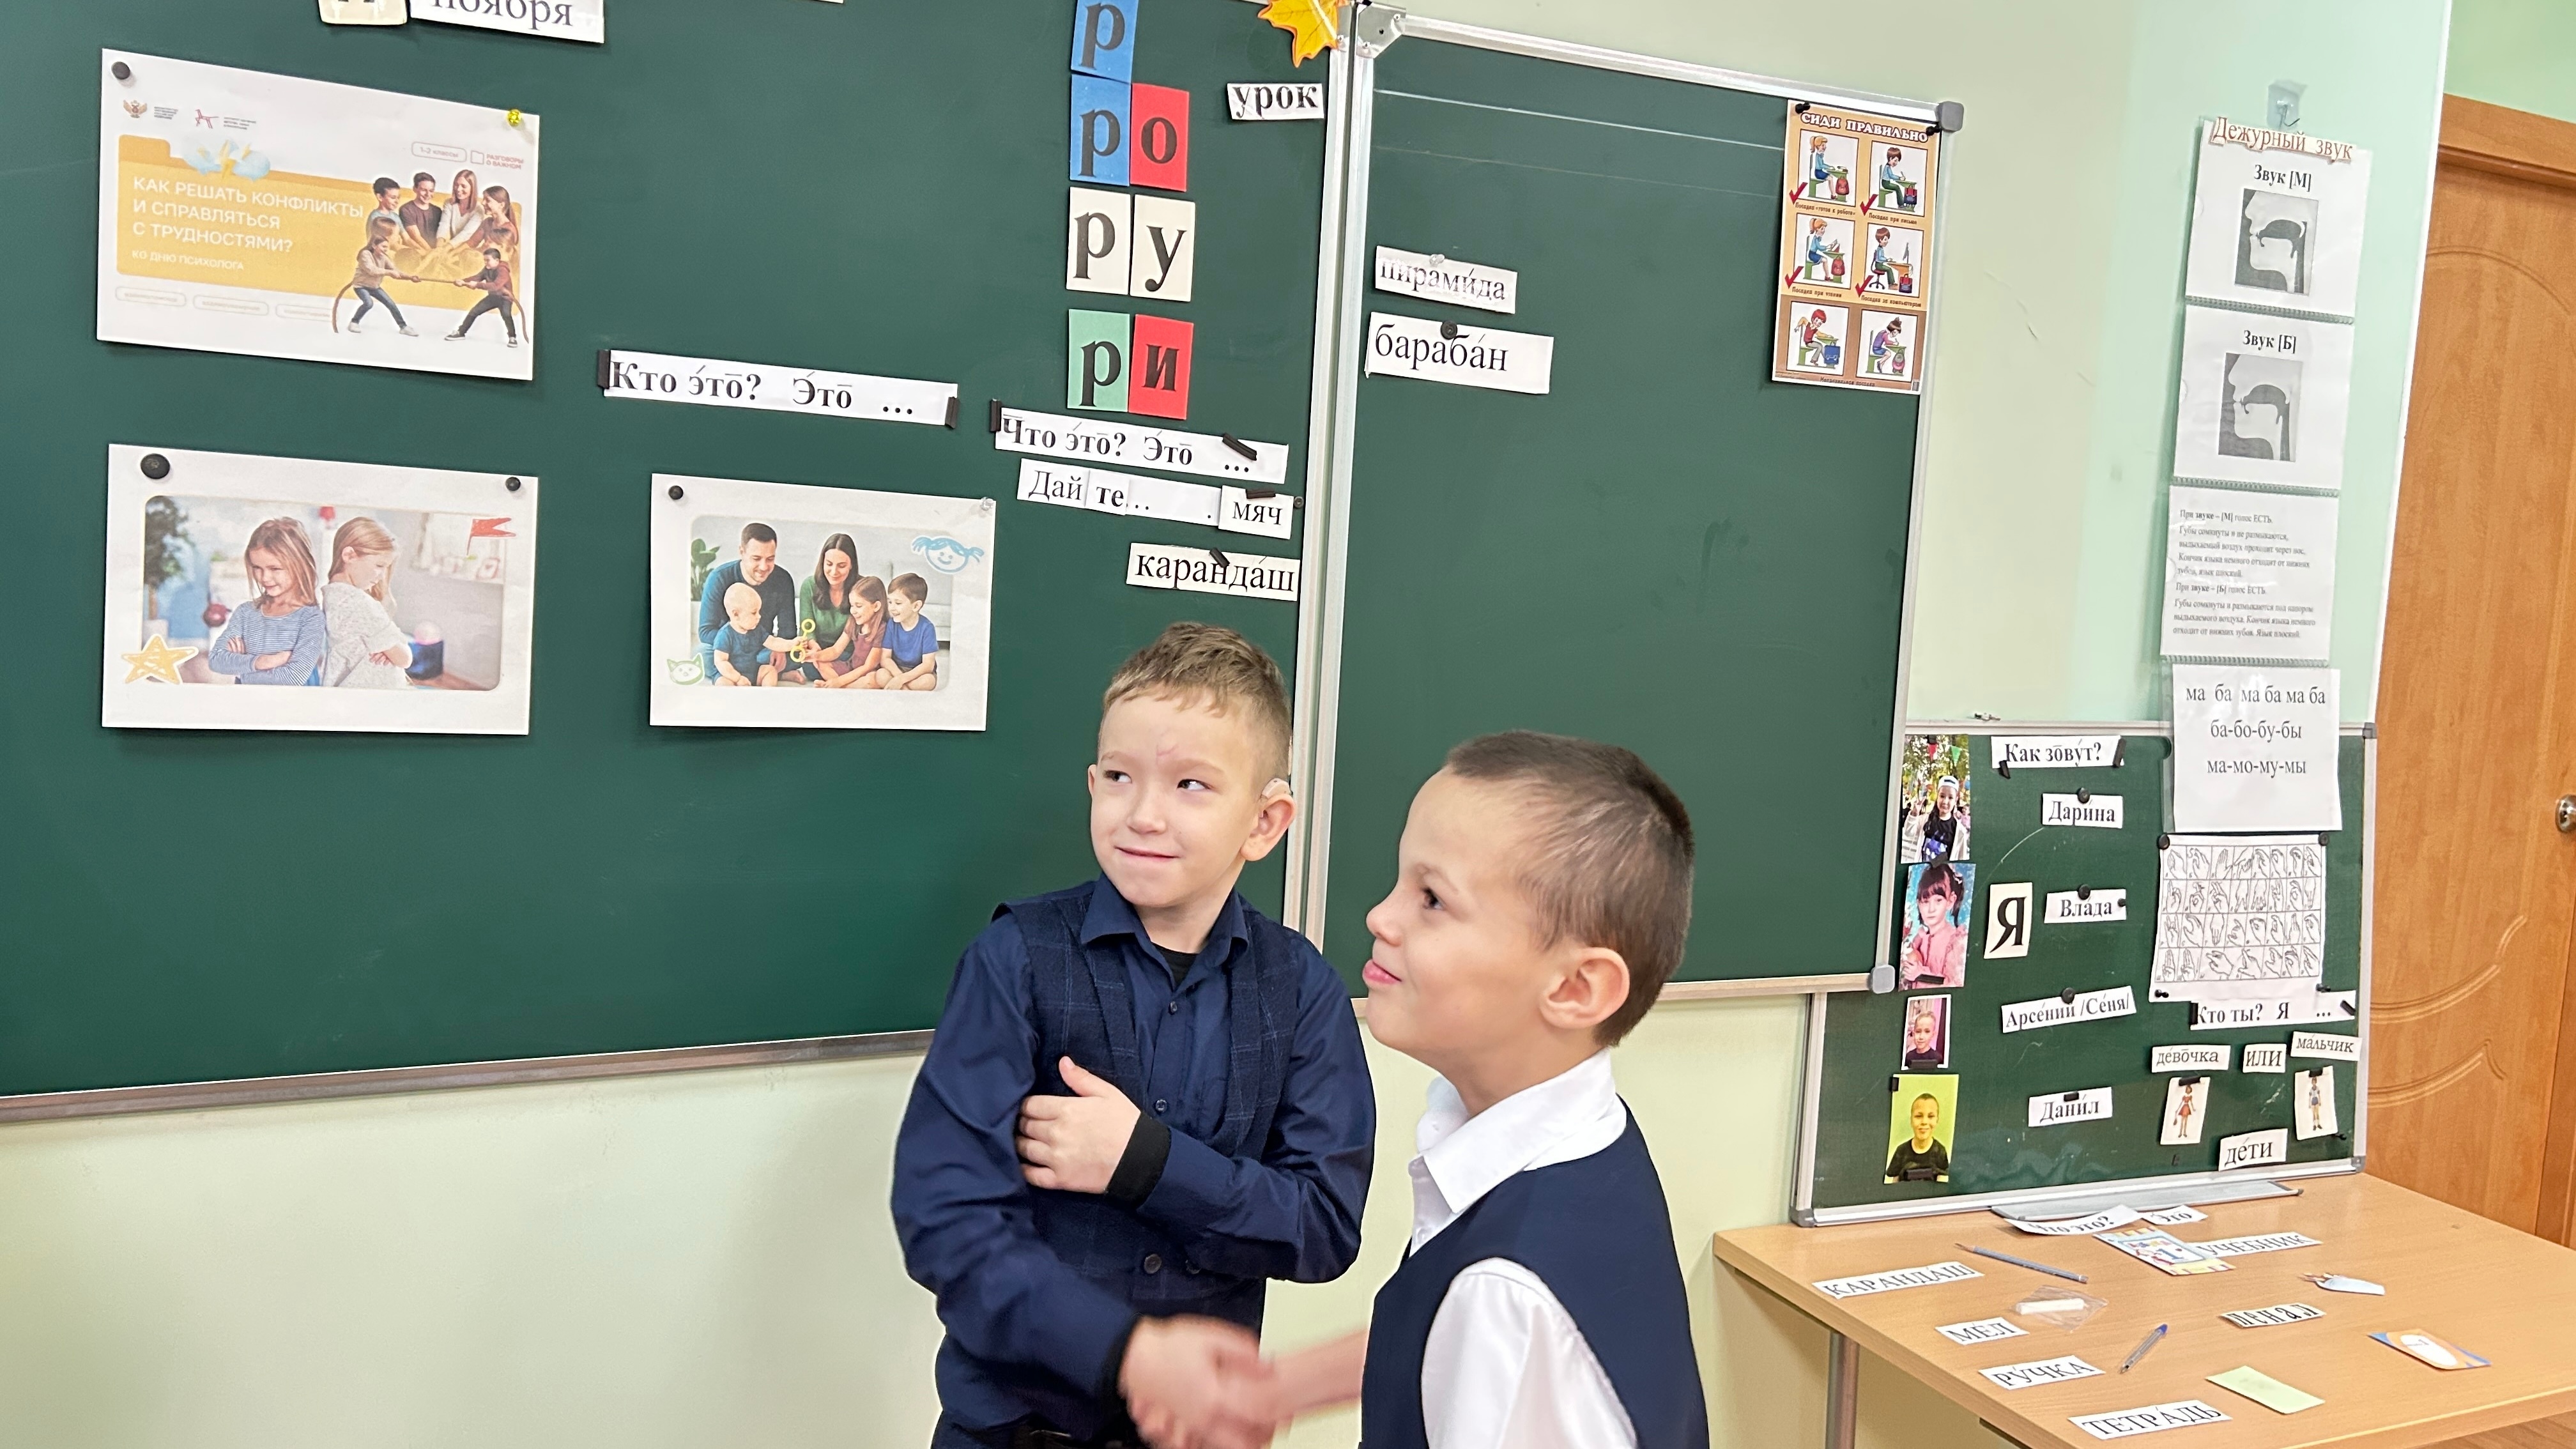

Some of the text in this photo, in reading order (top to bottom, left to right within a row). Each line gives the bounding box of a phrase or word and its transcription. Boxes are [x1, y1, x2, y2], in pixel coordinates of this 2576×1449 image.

[1079, 3, 1125, 68] р
[1232, 84, 1319, 119] урок
[1800, 112, 1929, 143] СИДИ ПРАВИЛЬНО
[2212, 116, 2354, 163] Дежурный звук
[486, 153, 525, 164] РАЗГОВОРЫ
[493, 160, 522, 170] ВАЖНОМ
[2253, 164, 2312, 192] Звук [М]
[134, 176, 364, 218] КАК РЕШАТЬ КОНФЛИКТЫ
[133, 199, 280, 229] И СПРАВЛЯТЬСЯ
[132, 222, 294, 253] С ТРУДНОСТЯМИ?
[132, 250, 244, 271] КО ДНЮ ПСИХОЛОГА
[2242, 330, 2297, 354] Звук [Б]
[611, 362, 677, 394] Кто
[1232, 501, 1283, 526] мяч
[2180, 509, 2193, 519] При
[2195, 512, 2214, 521] звуке
[2179, 525, 2196, 537] Губы
[2175, 582, 2189, 592] При
[2191, 584, 2210, 594] звуке
[2174, 598, 2192, 610] Губы
[2186, 683, 2326, 704] ма ба ма ба ма ба
[2210, 719, 2303, 743] ба-бо-бу-бы
[2005, 744, 2041, 762] Как
[2207, 760, 2307, 779] ма-мо-му-мы
[1989, 896, 2028, 954] Я
[2230, 1004, 2264, 1022] ты?
[2276, 1002, 2290, 1020] Я
[2228, 1303, 2319, 1326] пенал
